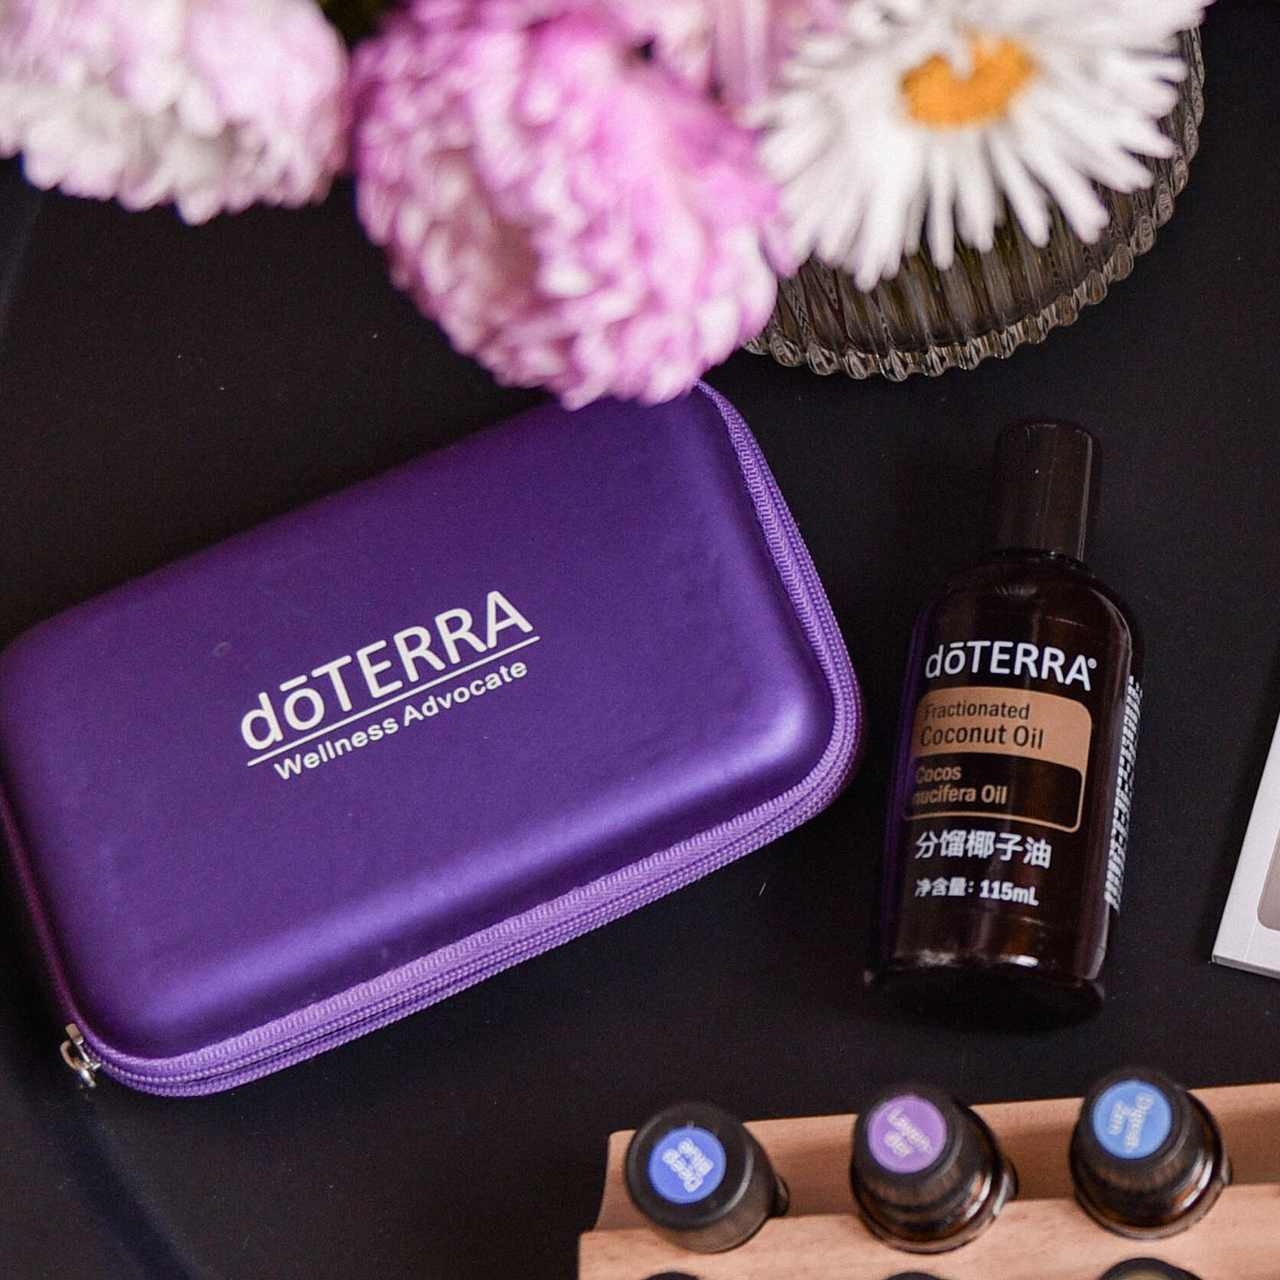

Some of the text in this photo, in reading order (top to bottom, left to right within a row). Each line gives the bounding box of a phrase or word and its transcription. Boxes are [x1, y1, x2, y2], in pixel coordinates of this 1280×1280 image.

[273, 659, 529, 781] Wellness Advocate
[924, 699, 1031, 721] Fractionated
[920, 724, 1046, 750] Coconut Oil
[915, 765, 963, 784] Cocos
[912, 784, 1009, 805] nucifera Oil
[914, 828, 1053, 869] 分馏椰子油
[1108, 1100, 1132, 1136] Zen
[677, 1137, 714, 1176] Blue
[883, 1130, 915, 1158] der
[661, 1147, 704, 1194] Deep
